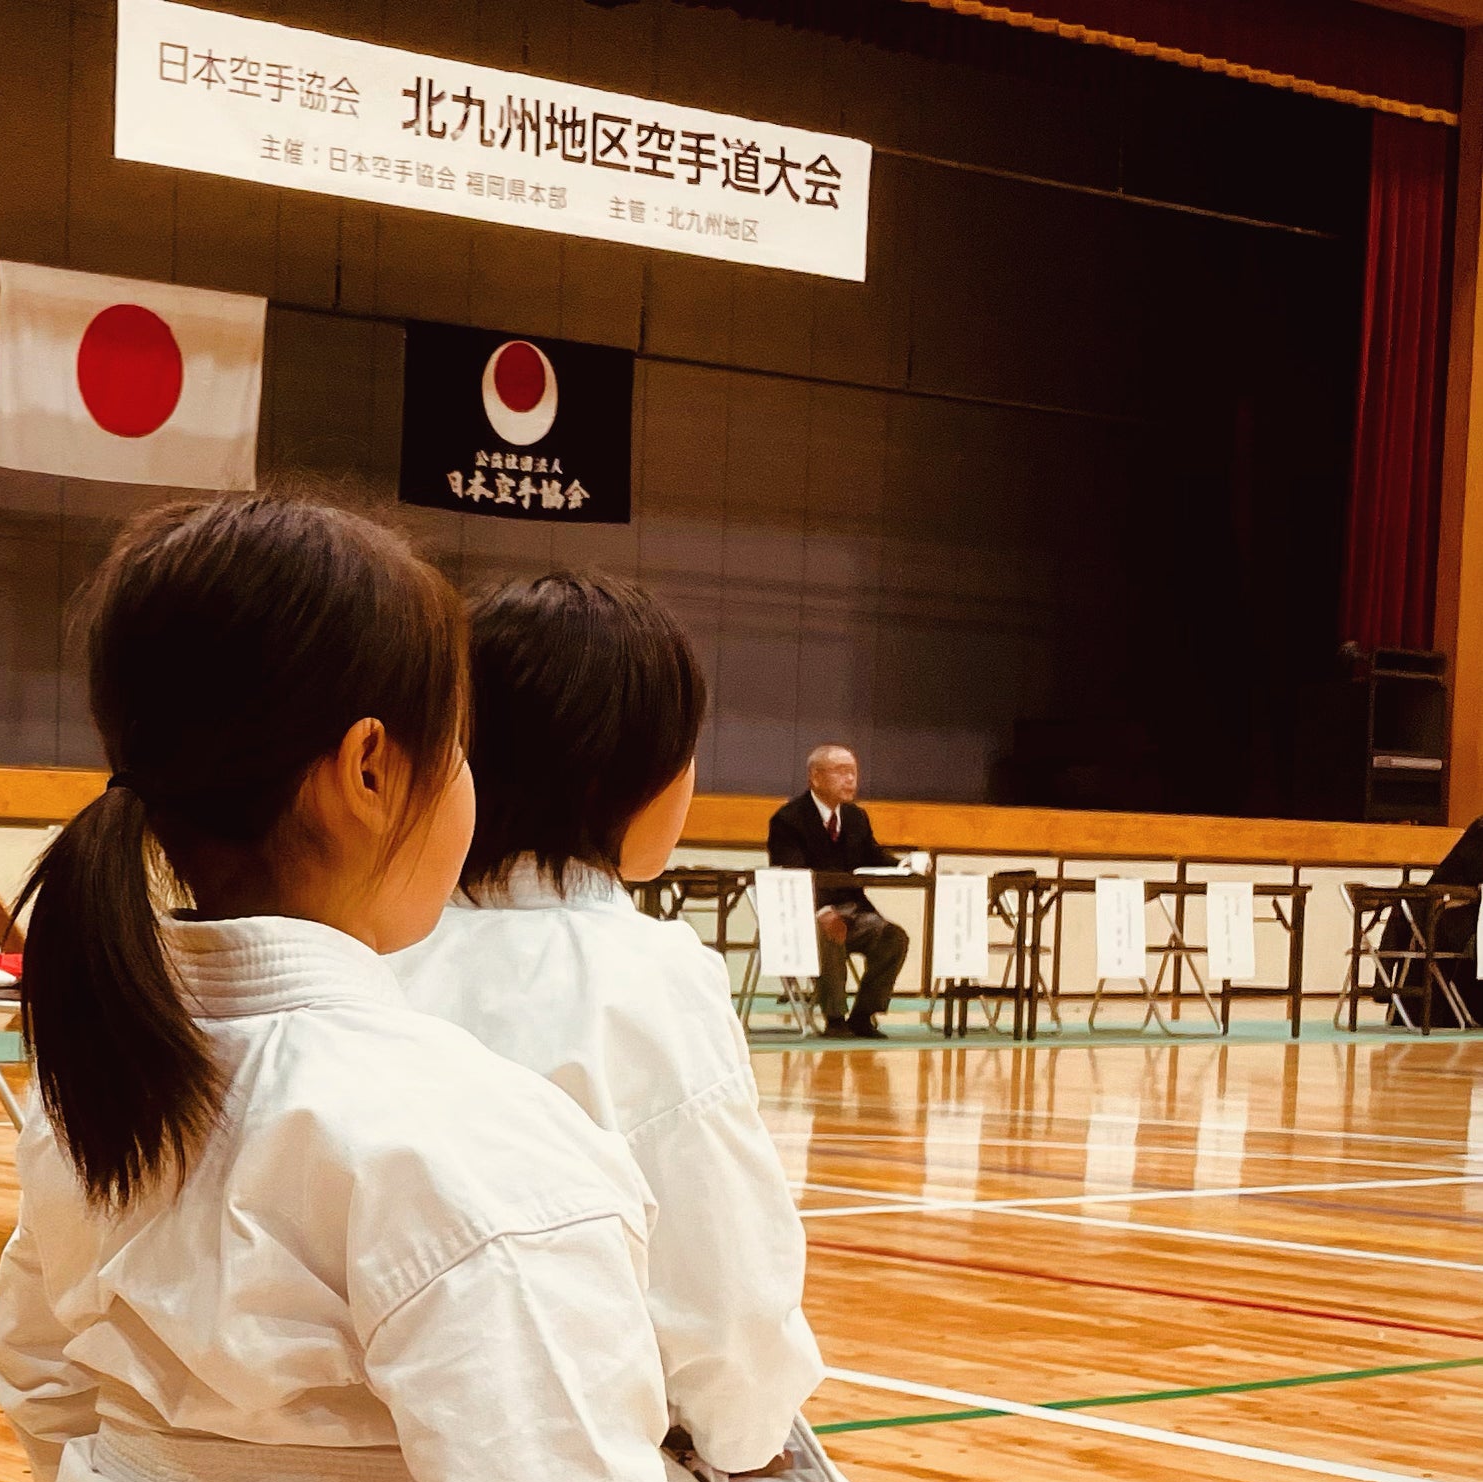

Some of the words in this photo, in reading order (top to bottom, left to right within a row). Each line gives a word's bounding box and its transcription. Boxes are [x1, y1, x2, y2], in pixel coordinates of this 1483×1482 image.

[159, 42, 360, 118] 日本空手協会
[402, 76, 842, 210] 北九州地区空手道大会
